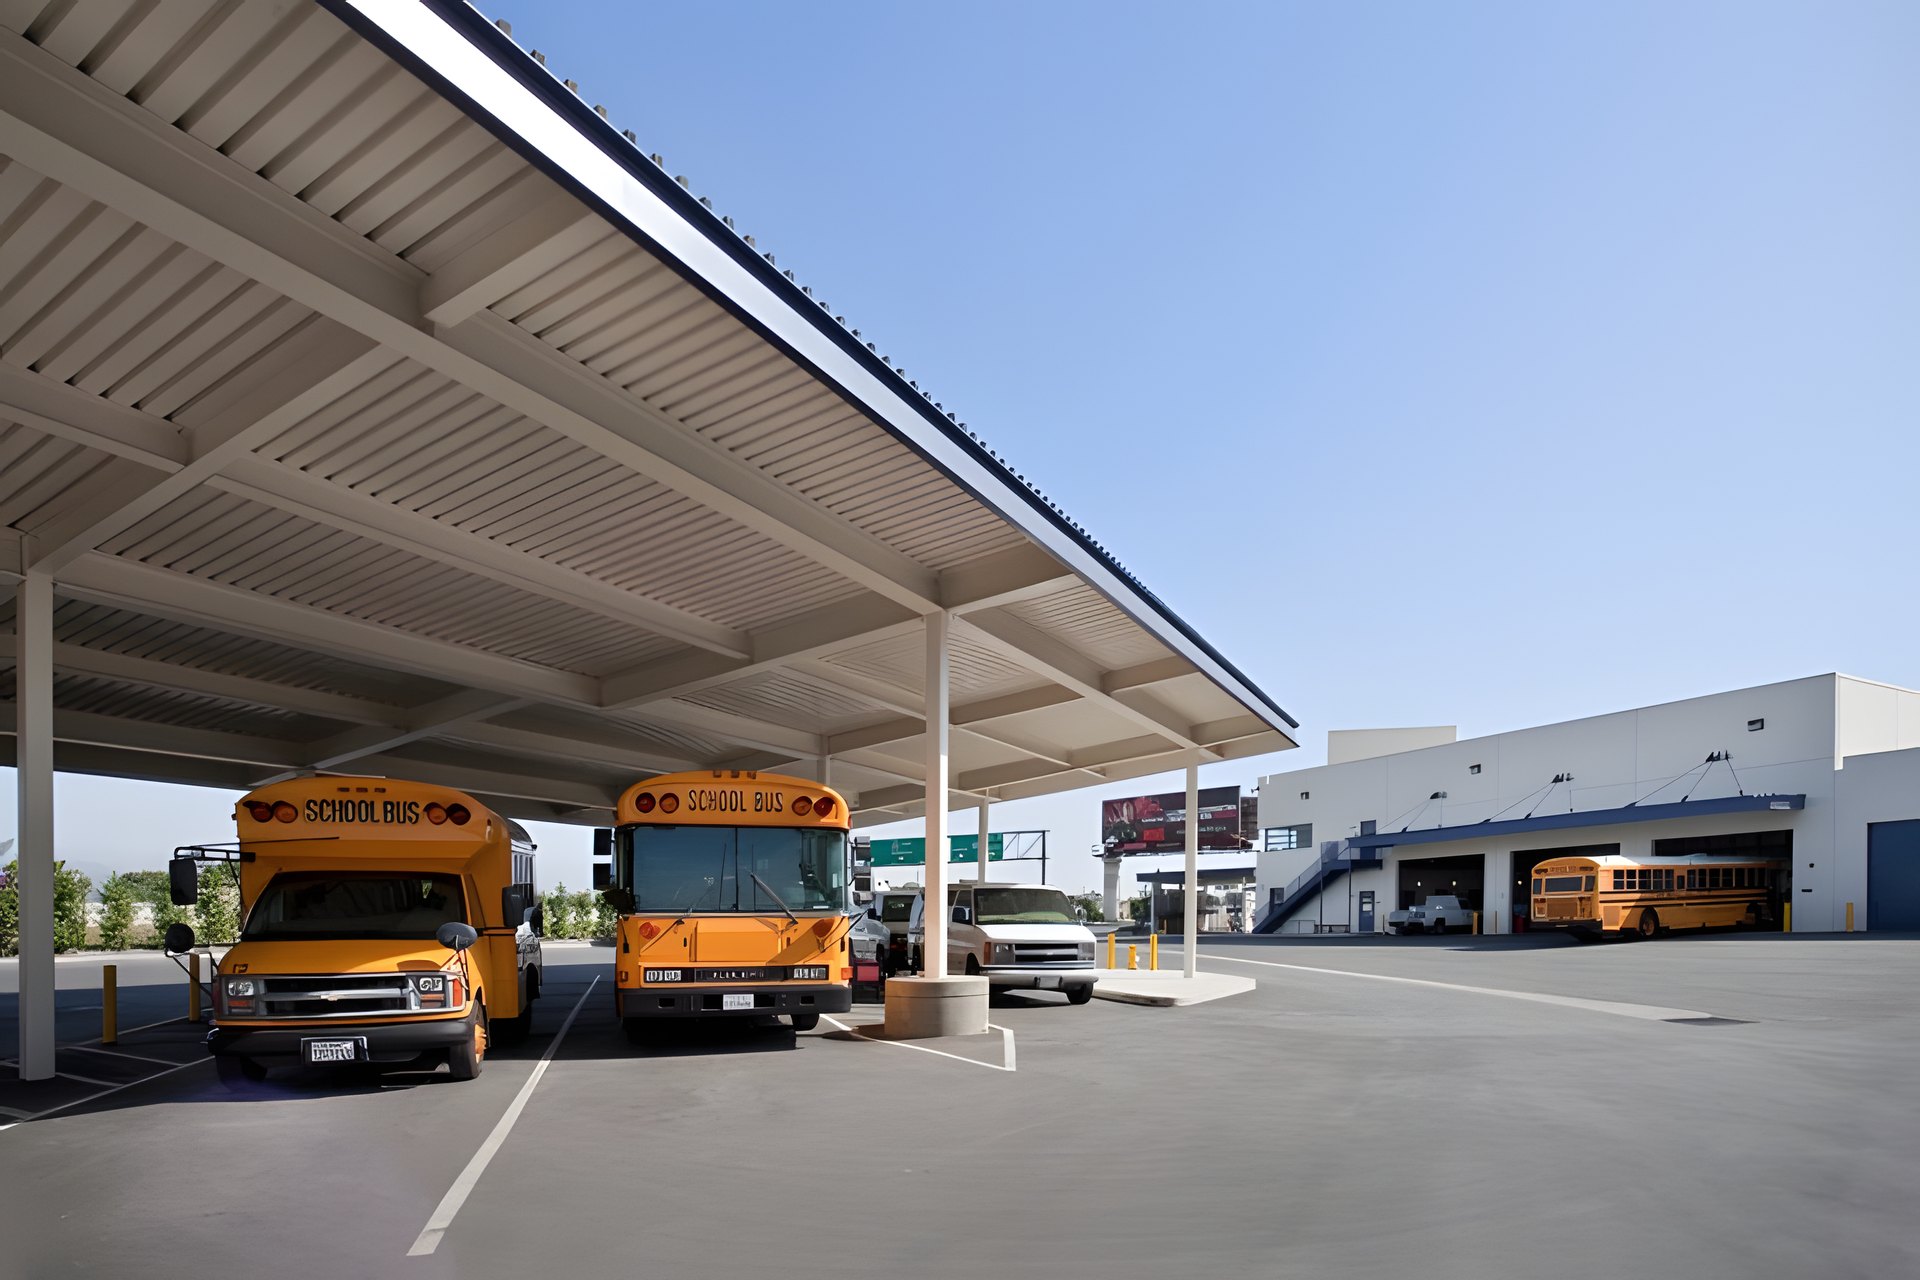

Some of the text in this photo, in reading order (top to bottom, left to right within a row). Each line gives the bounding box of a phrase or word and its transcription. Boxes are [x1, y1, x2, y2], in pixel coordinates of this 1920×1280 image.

[305, 799, 420, 824] SCHOOL BUS
[688, 789, 784, 812] SCHOOL BUS
